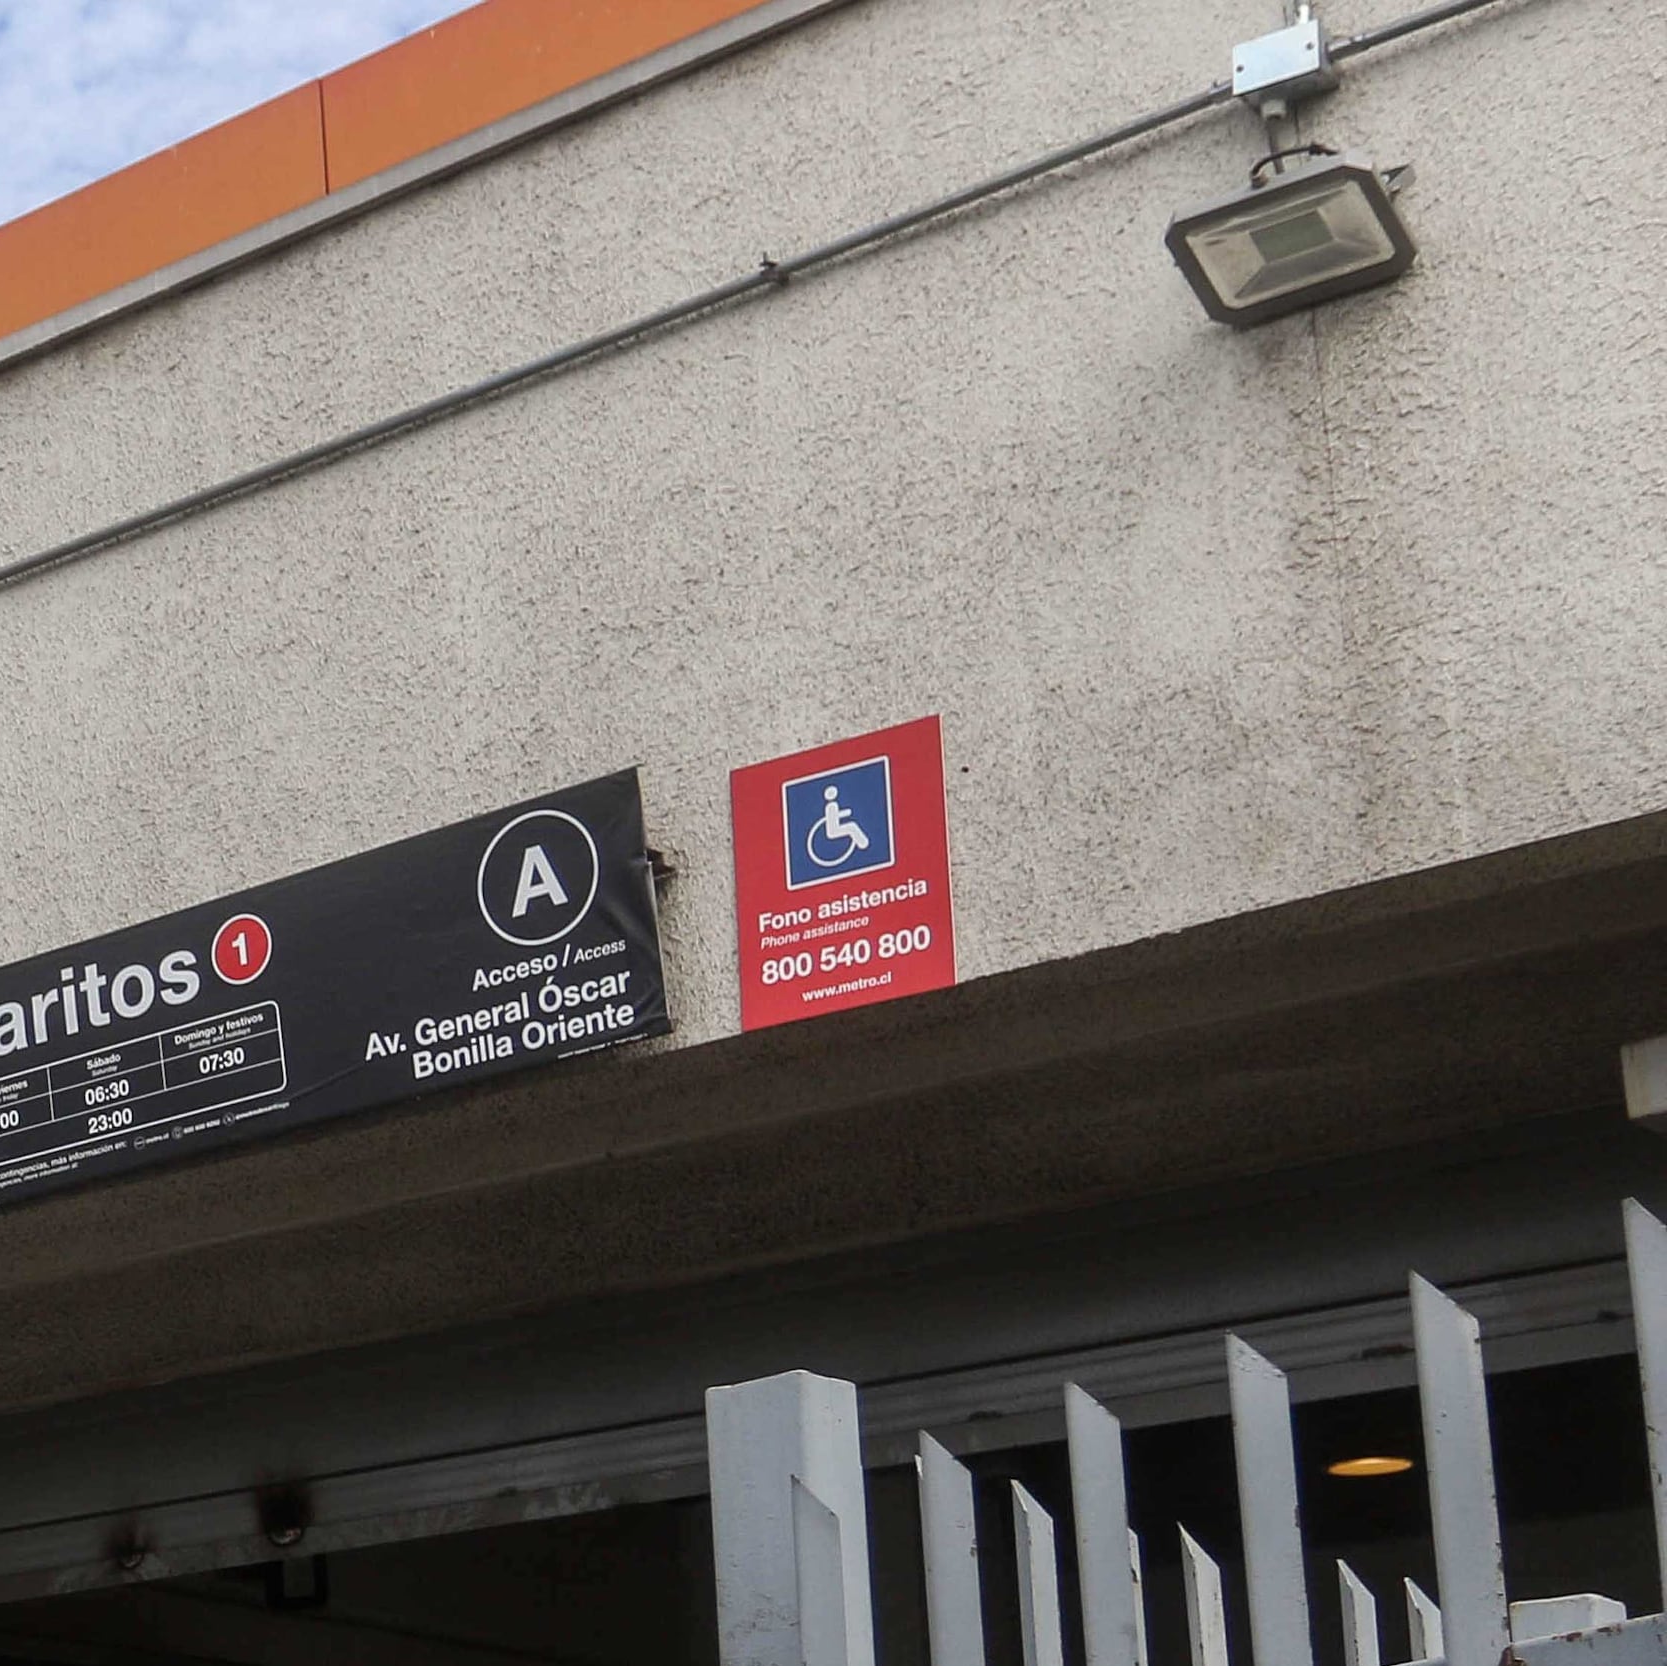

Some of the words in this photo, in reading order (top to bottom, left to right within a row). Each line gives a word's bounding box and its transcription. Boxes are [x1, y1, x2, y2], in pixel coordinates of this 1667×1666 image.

[511, 843, 569, 918] A
[757, 907, 812, 933] Fono
[818, 878, 928, 920] asistencia
[760, 929, 801, 950] Phone
[802, 916, 870, 941] assistance
[472, 953, 558, 992] Acceso
[573, 938, 627, 964] Access
[761, 952, 813, 985] 800
[819, 938, 871, 972] 540
[878, 925, 932, 959] 800
[801, 971, 893, 1002] www.metro.cl
[174, 1026, 217, 1045] Domingo
[226, 1013, 264, 1031] festivos
[365, 1031, 407, 1061] Av.
[414, 992, 531, 1046] General
[538, 970, 632, 1013] Óscar
[412, 1033, 514, 1079] Bonilla
[521, 1002, 636, 1050] Oriente
[87, 1053, 122, 1070] Sábado
[199, 1047, 245, 1075] 07:30
[84, 1079, 130, 1106] 06:30
[88, 1108, 133, 1135] 23:00
